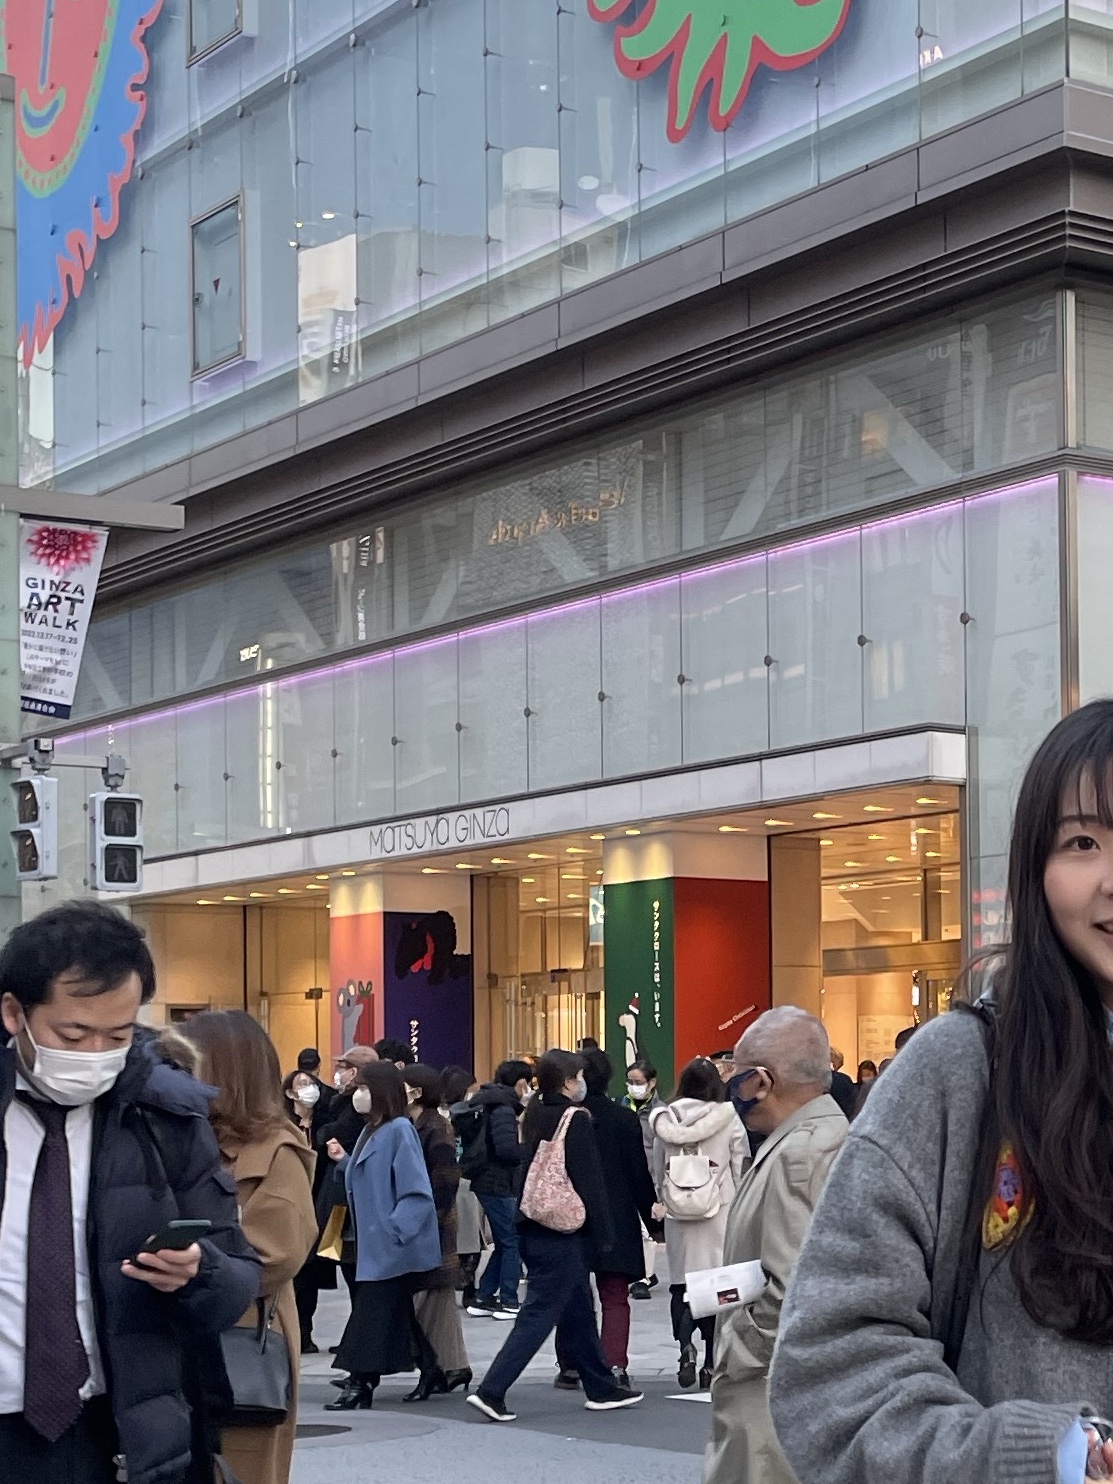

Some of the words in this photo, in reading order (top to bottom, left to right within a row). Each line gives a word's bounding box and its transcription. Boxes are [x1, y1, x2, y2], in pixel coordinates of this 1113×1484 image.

[25, 577, 85, 596] GINZA
[26, 592, 84, 615] ART
[23, 611, 79, 632] WALK
